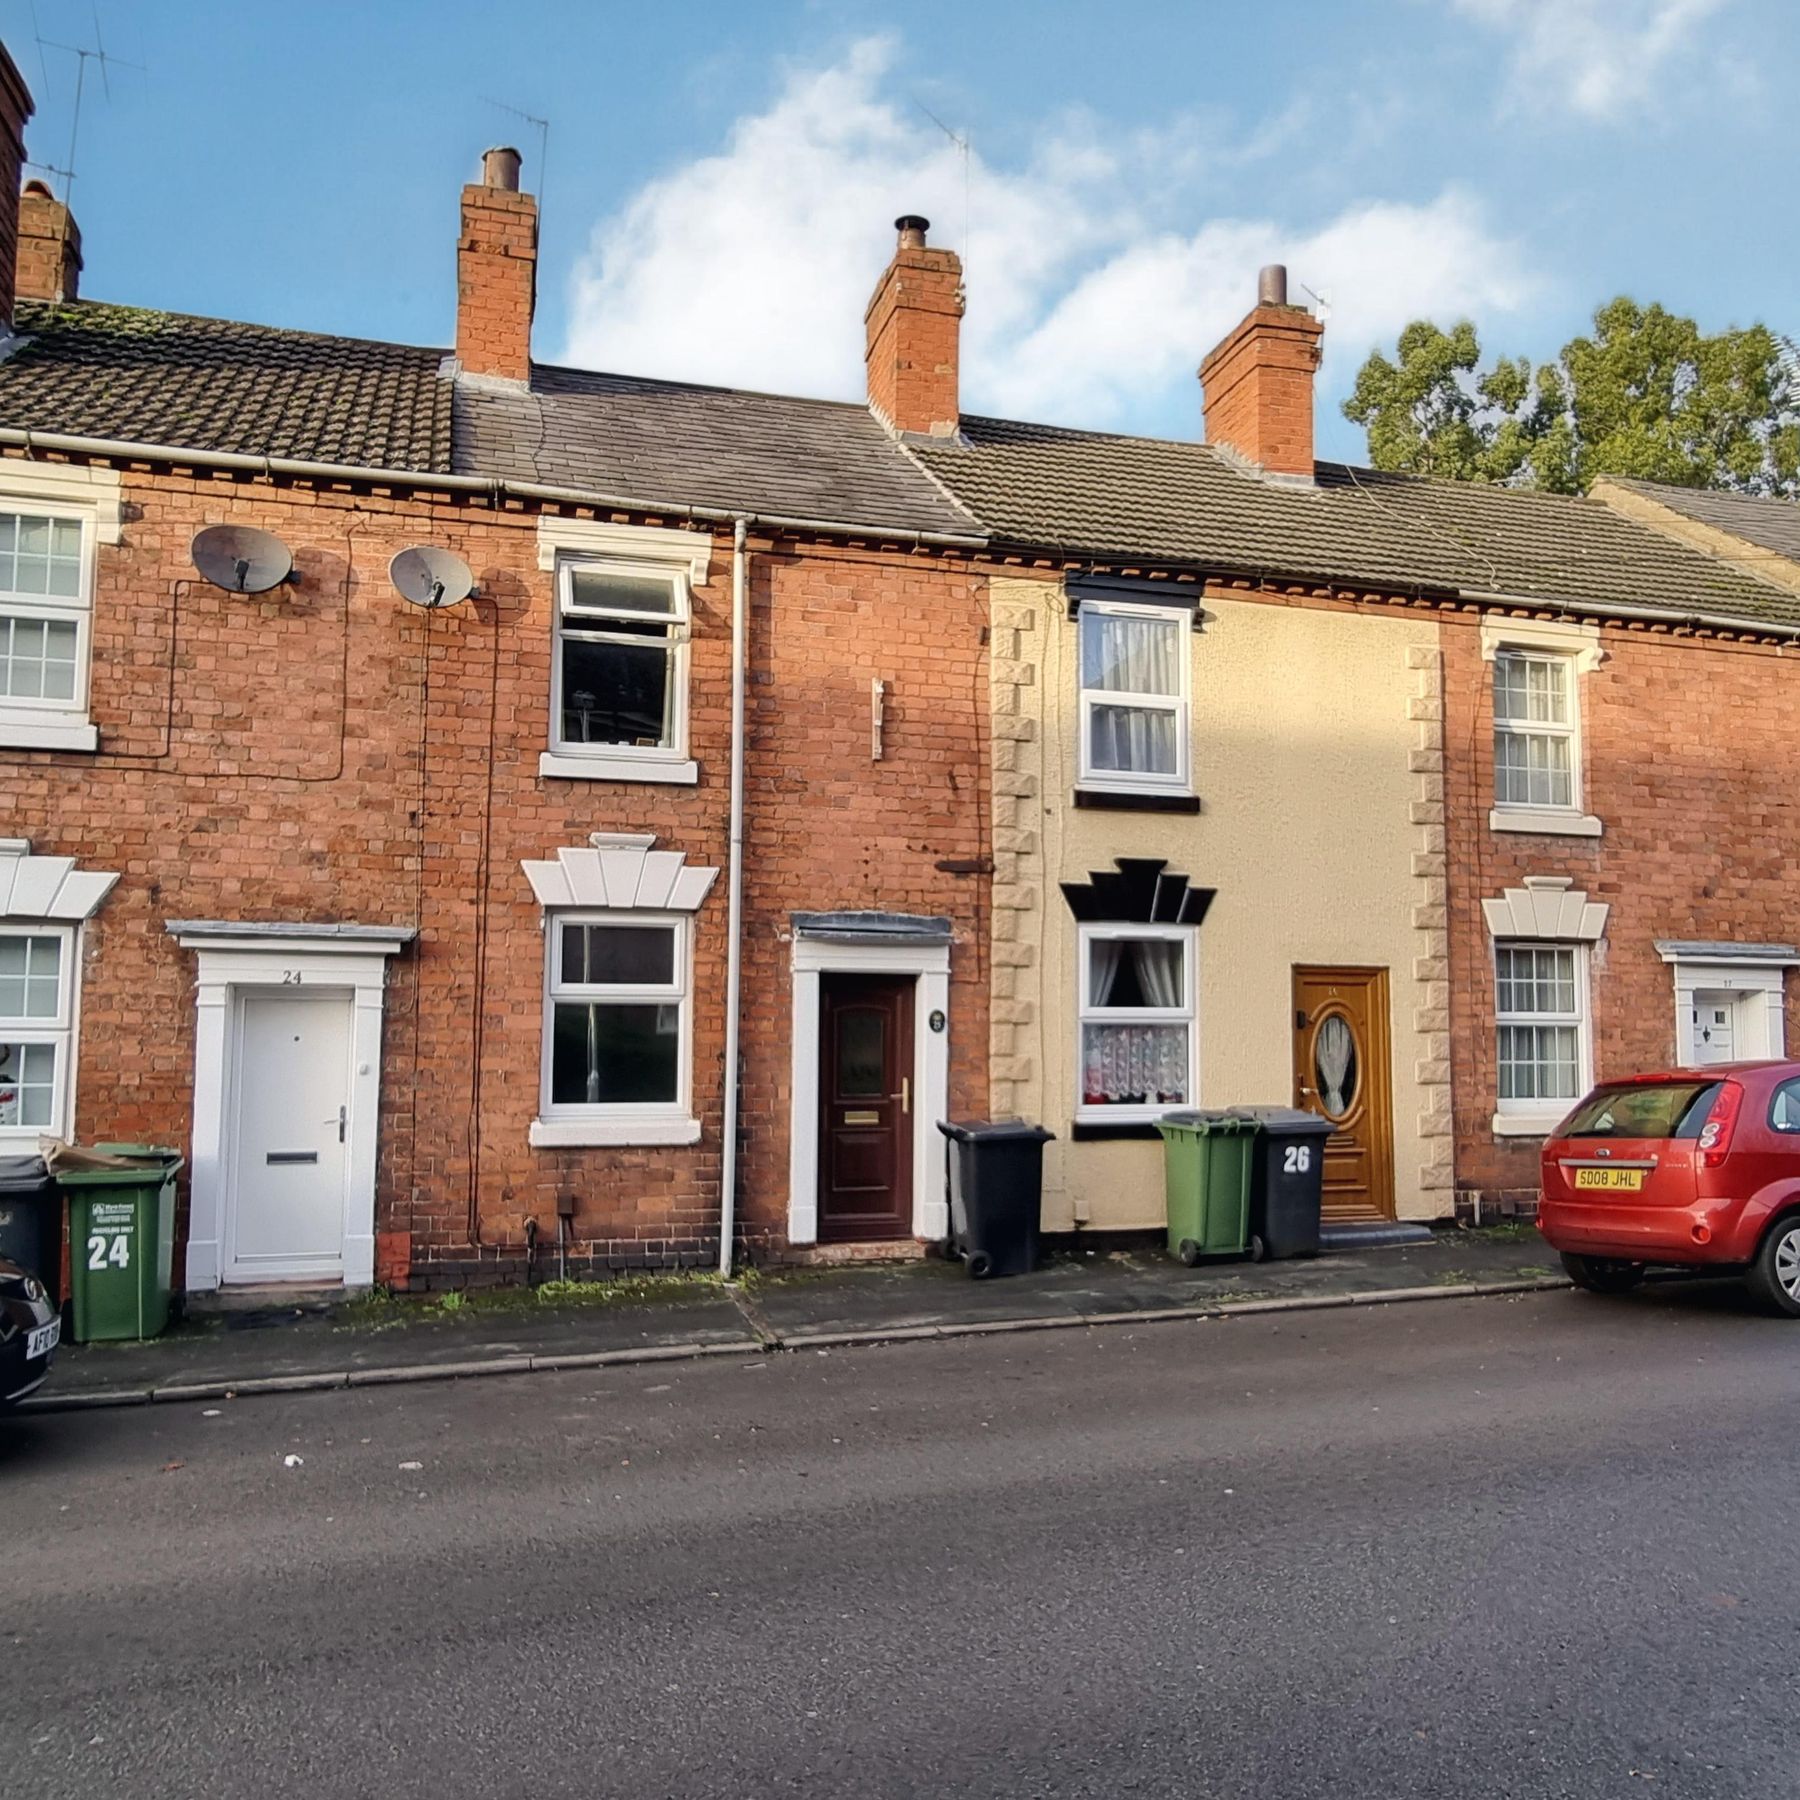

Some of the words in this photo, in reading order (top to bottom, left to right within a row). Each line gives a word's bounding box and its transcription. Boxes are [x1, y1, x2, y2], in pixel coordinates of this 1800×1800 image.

[283, 970, 302, 985] 24
[1283, 1145, 1310, 1173] 26
[1580, 1170, 1608, 1186] SD08
[1611, 1170, 1636, 1187] JHL
[88, 1235, 130, 1270] 24
